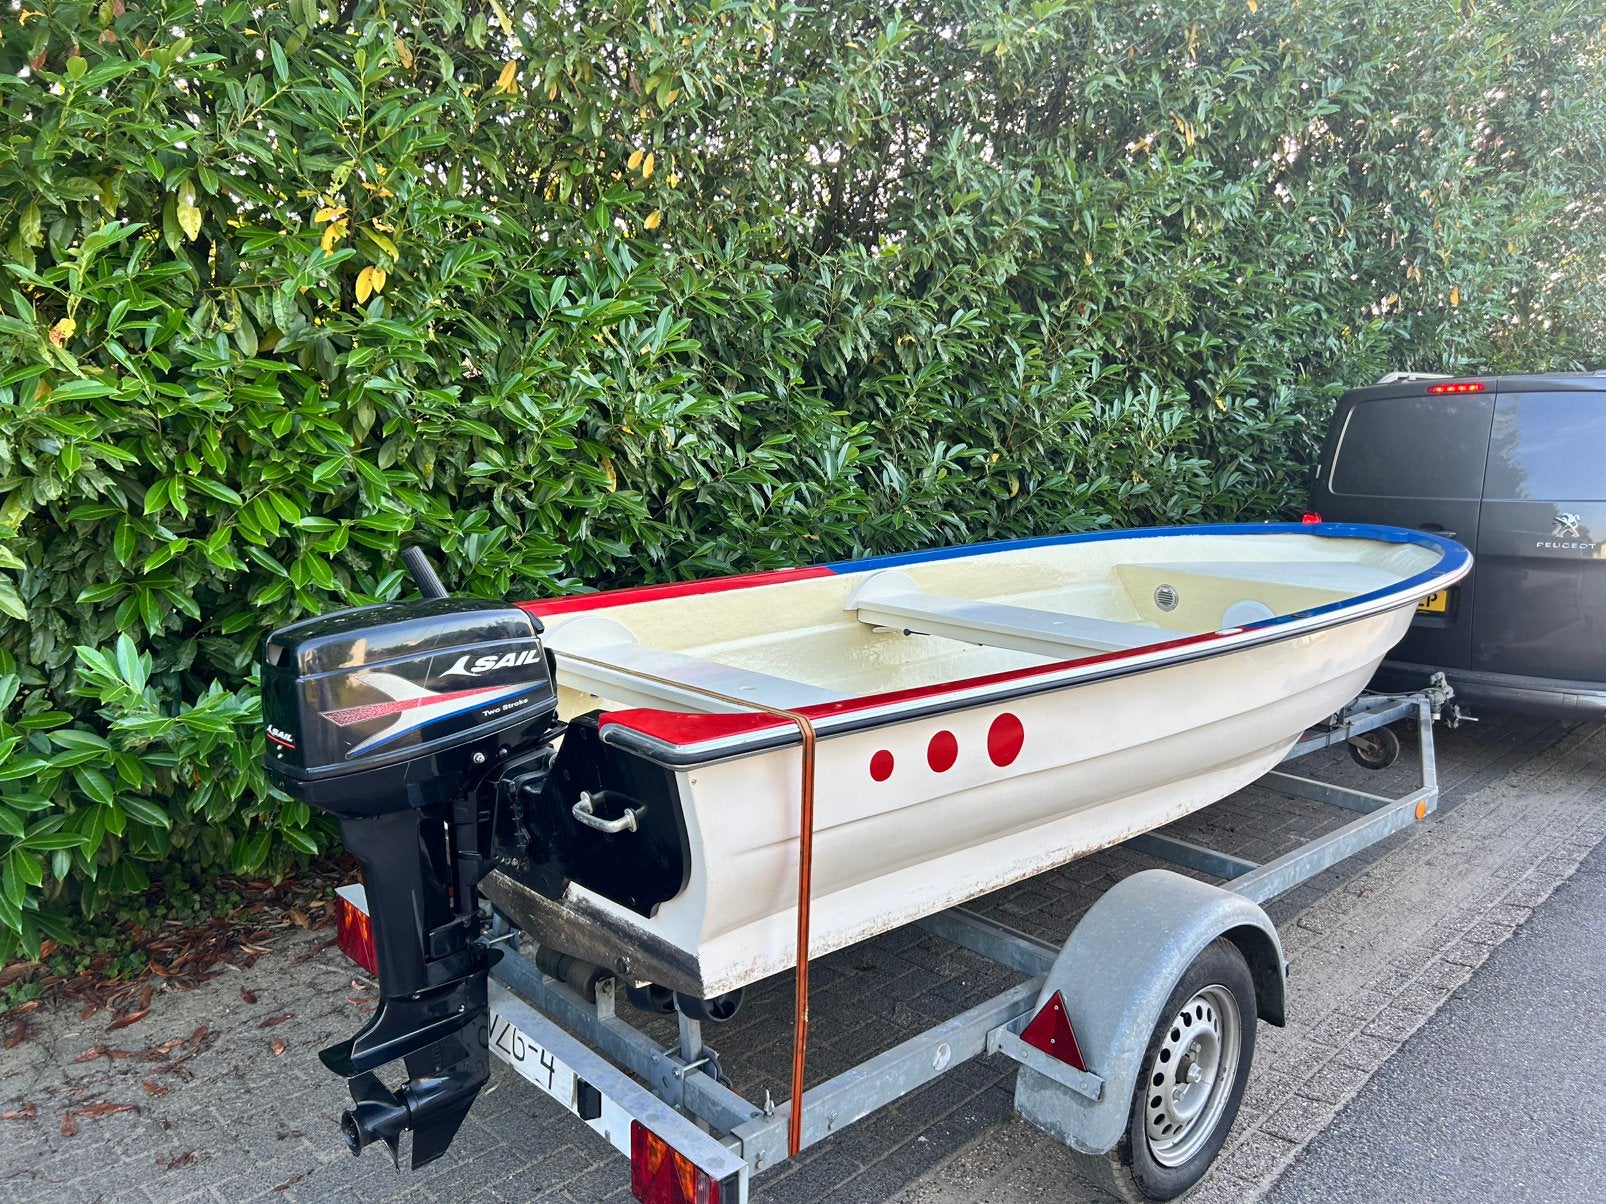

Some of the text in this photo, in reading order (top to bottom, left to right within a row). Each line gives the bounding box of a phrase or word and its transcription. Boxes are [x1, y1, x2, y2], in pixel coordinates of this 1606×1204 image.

[470, 649, 541, 673] SAIL
[482, 698, 529, 717] Two Stroke
[271, 727, 293, 742] SAIL
